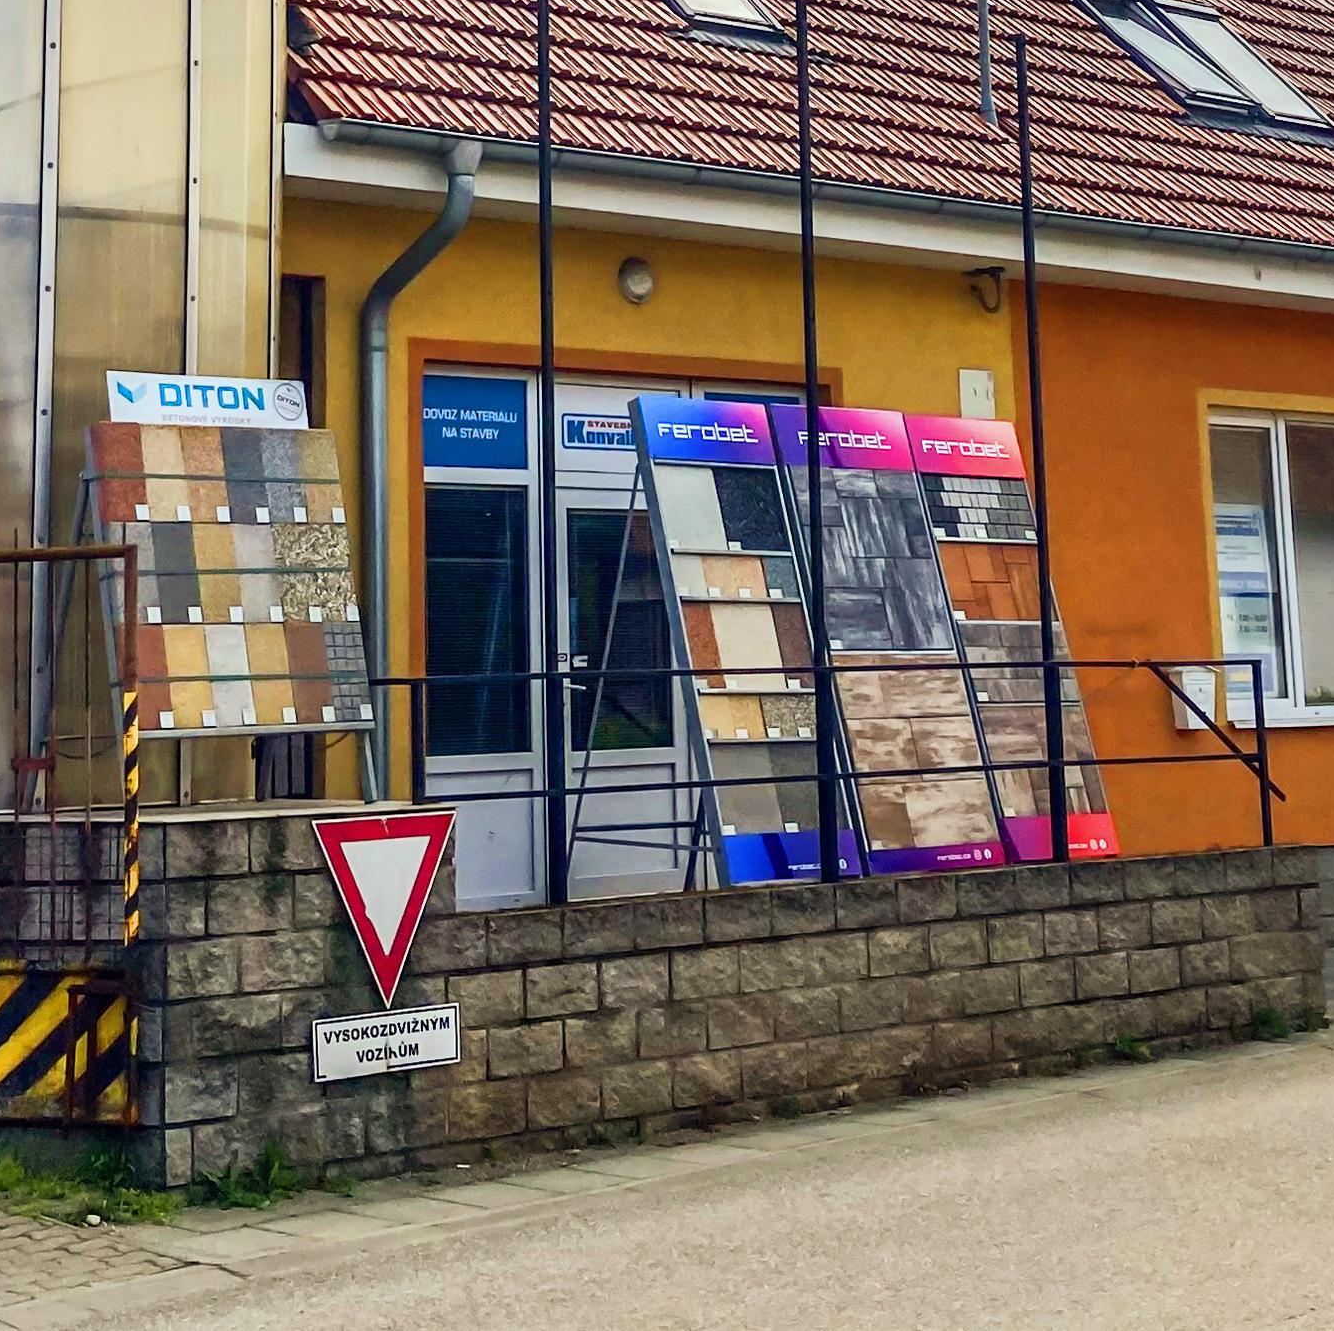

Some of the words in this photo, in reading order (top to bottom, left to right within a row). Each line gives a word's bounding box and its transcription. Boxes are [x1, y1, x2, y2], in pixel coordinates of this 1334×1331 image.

[158, 383, 265, 411] DITON
[276, 394, 301, 408] DITON
[423, 407, 458, 420] DOVOZ
[442, 426, 458, 438] NA
[460, 427, 499, 440] STAVBY
[324, 1016, 450, 1044] VYSOKOZDVIŽNÝM
